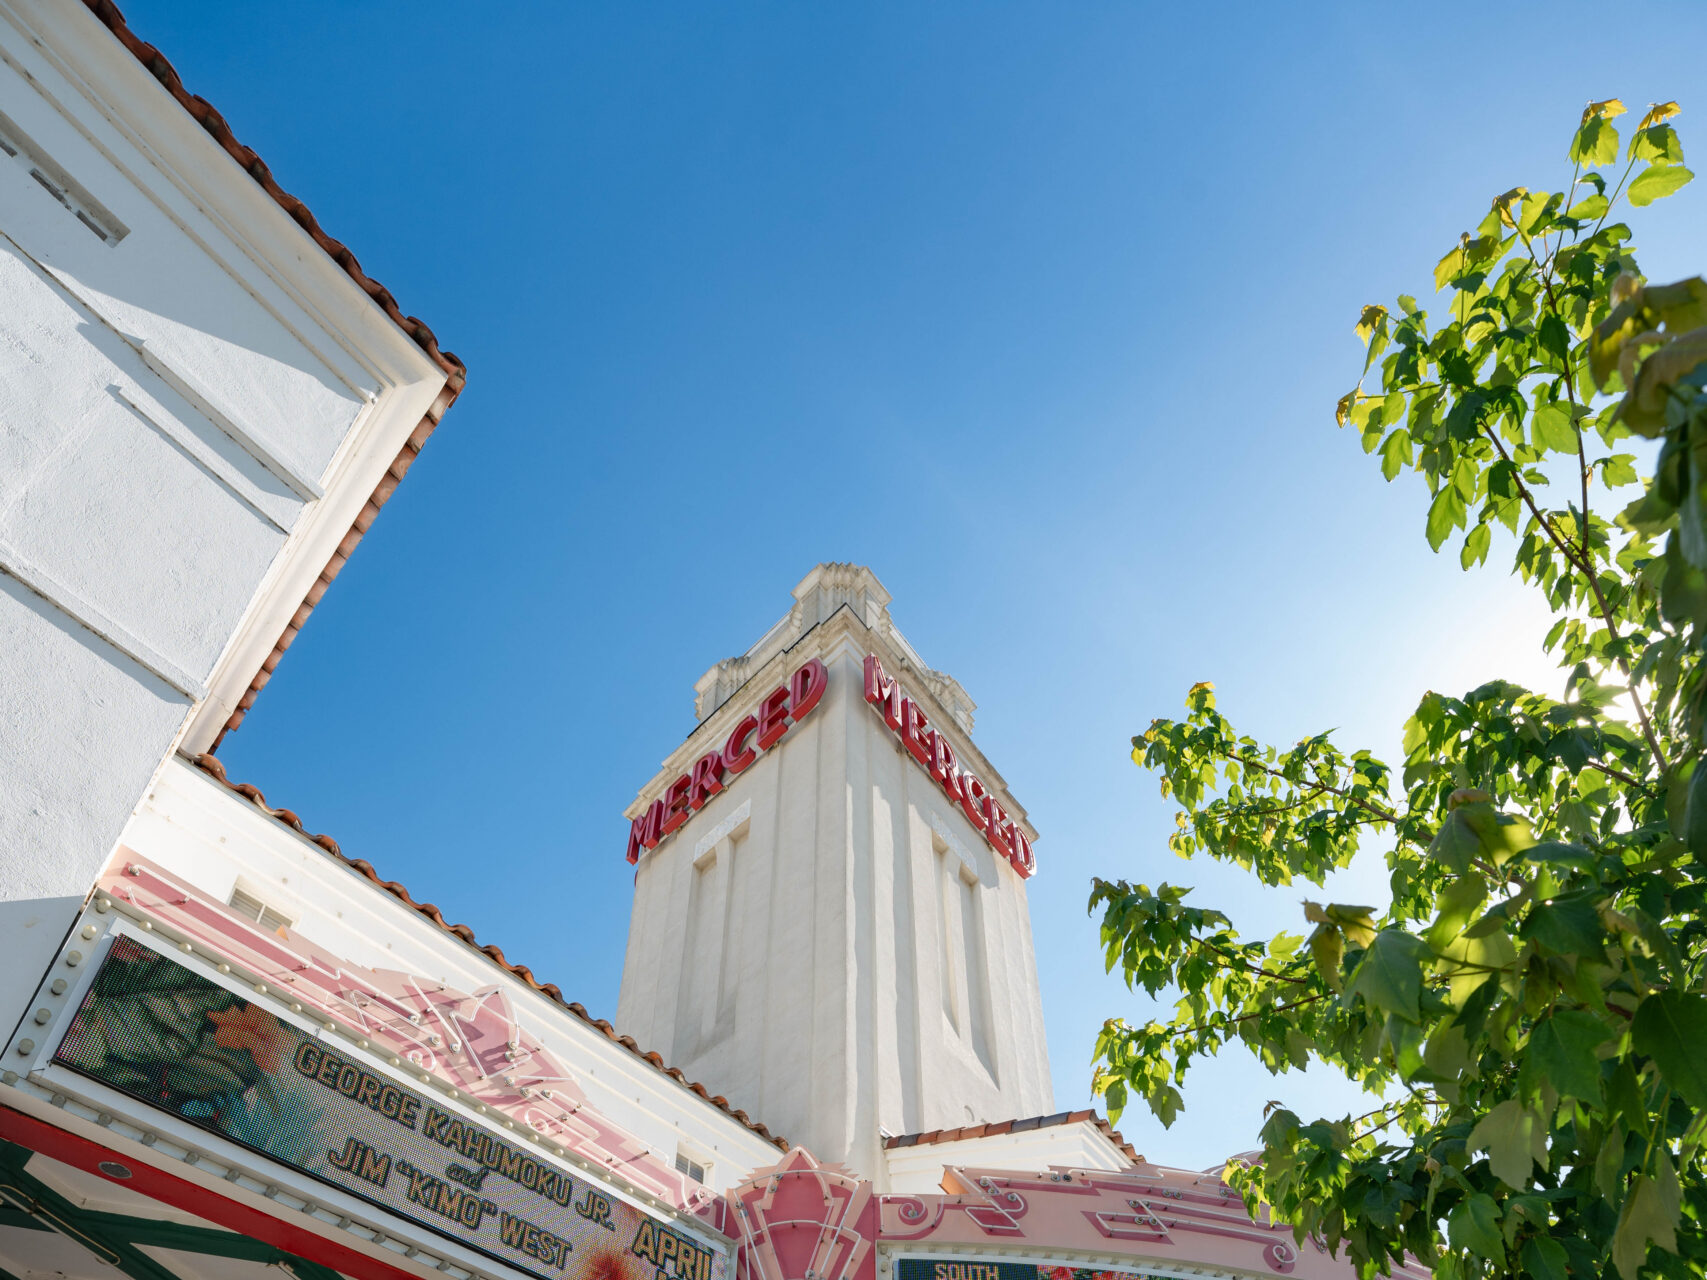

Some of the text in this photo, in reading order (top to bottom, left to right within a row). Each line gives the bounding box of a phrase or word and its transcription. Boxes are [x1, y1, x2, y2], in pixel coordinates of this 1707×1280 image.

[626, 657, 829, 866] MERCED
[864, 652, 1037, 880] MERCED
[294, 1042, 616, 1232] GEORGE KAHUMOKU JR.
[447, 1163, 489, 1191] and
[499, 1210, 573, 1270] WEST
